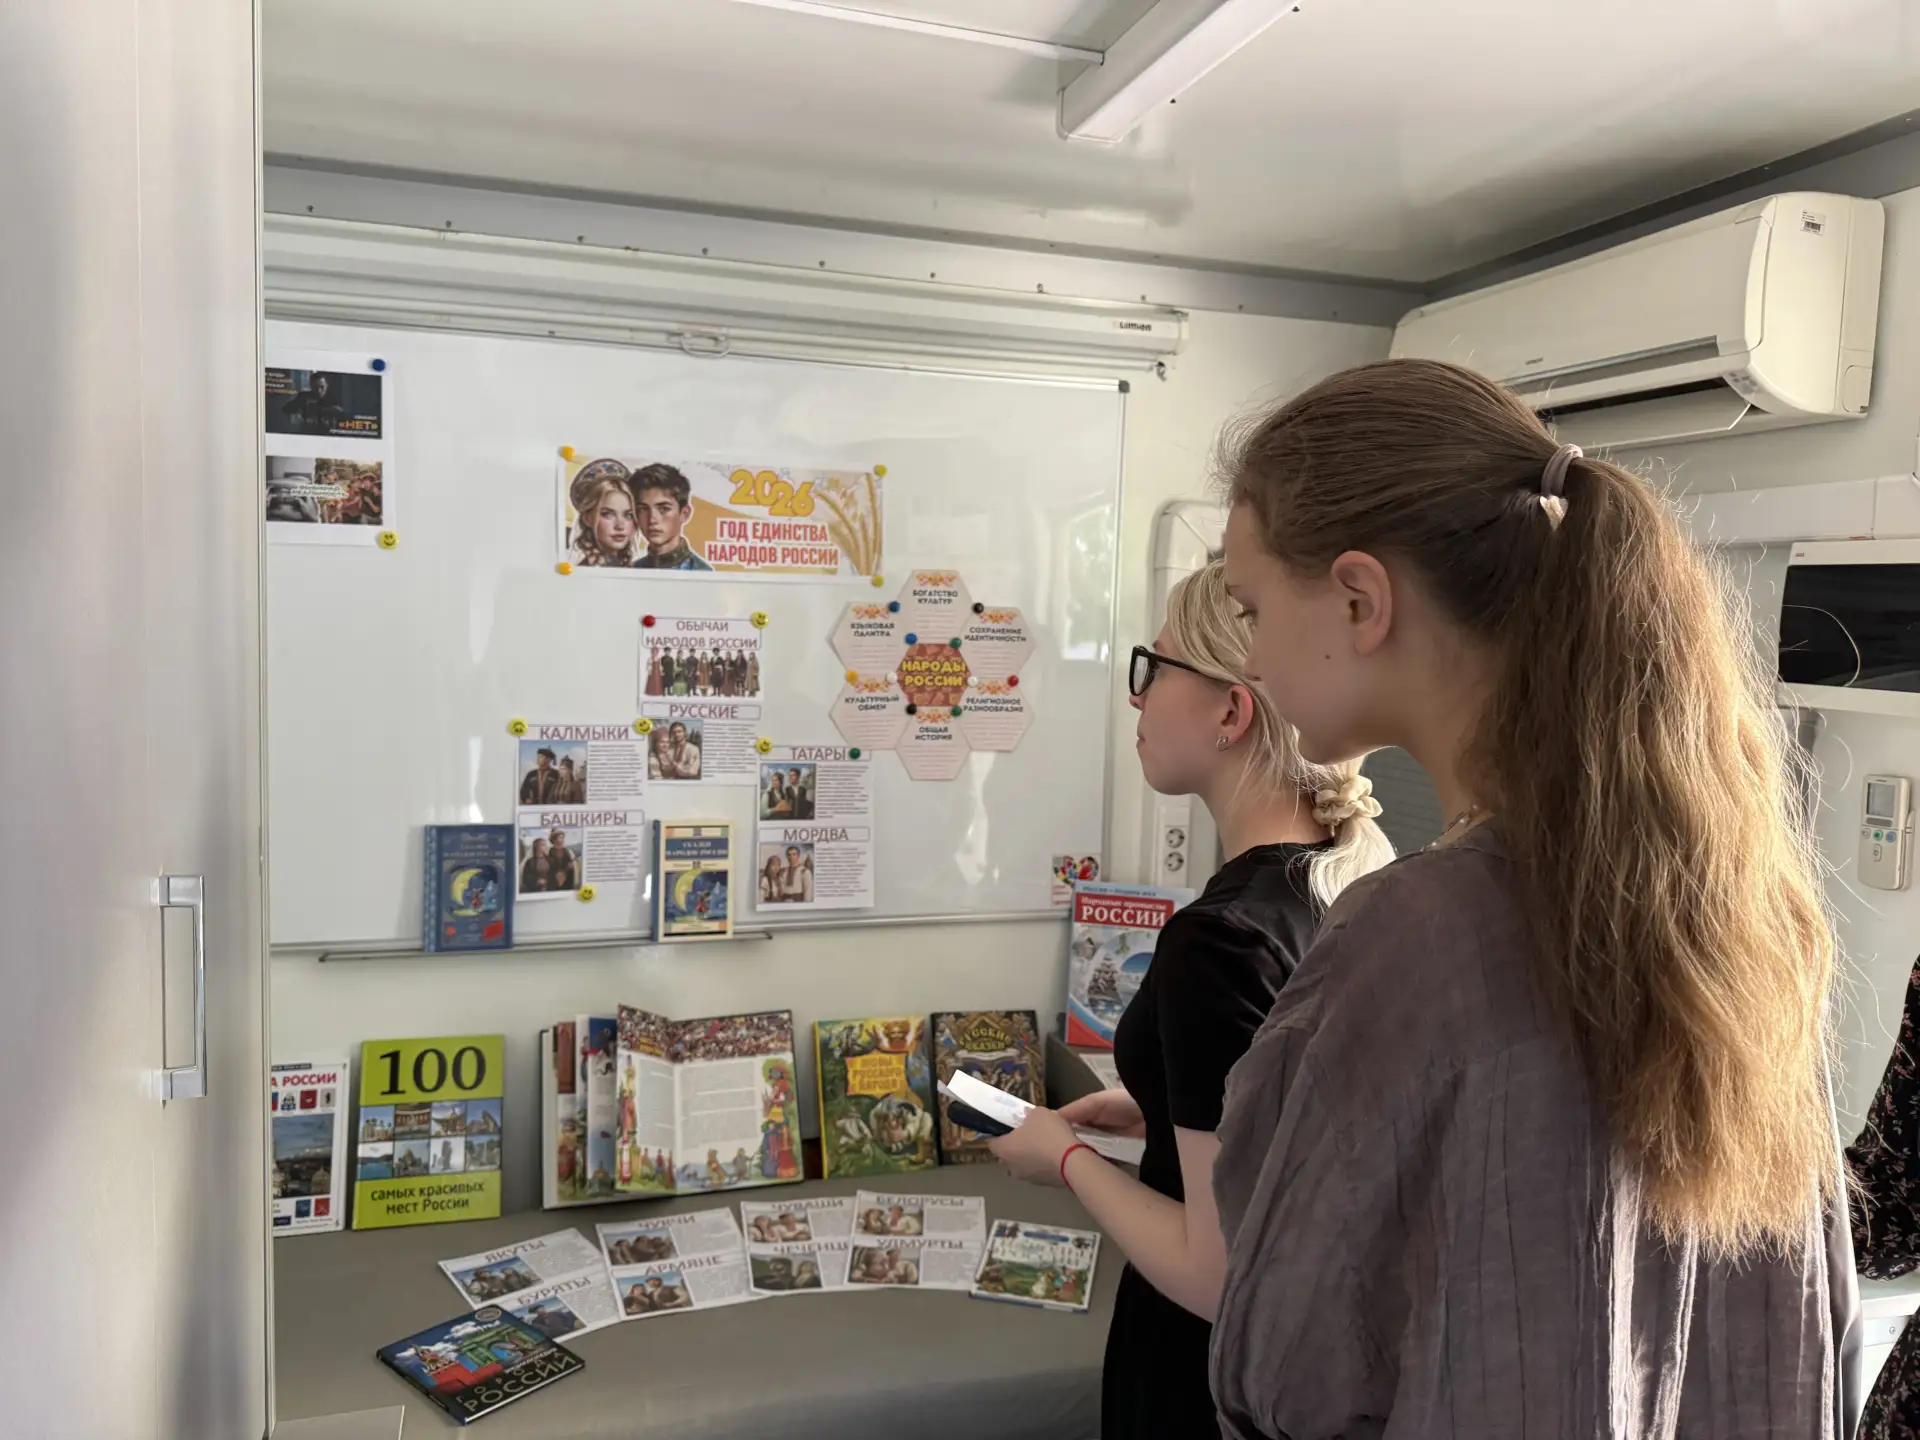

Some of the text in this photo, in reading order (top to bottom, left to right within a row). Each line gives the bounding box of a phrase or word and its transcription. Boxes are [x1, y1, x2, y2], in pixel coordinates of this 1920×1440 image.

[729, 469, 815, 517] 2026
[718, 520, 828, 543] ГОД ЕДИНСТВА
[707, 544, 838, 566] НАРОДОВ РОССИИ
[912, 589, 958, 597] БОГАТСТВО
[645, 636, 758, 648] НАРОДОВ РОССИИ
[902, 660, 966, 673] НАРОДЫ
[904, 675, 963, 687] РОССИИ
[844, 694, 900, 703] КУЛЬТУРНЫЙ
[965, 697, 1021, 705] РЕЛИГИОЗНОЕ
[669, 703, 739, 719] РУССКИЕ
[539, 726, 630, 741] КАЛМЫКИ
[790, 747, 846, 761] ТАТАРЫ
[540, 811, 628, 827] БАШКИРЫ
[783, 828, 849, 844] МОРДВА
[1081, 905, 1166, 927] РОССИИ
[379, 1046, 486, 1096] 100
[282, 1072, 337, 1087] РОССИИ
[371, 1182, 485, 1202] самых красивых
[386, 1198, 470, 1216] мест России
[875, 1195, 965, 1207] БЕЛОРУСЫ
[484, 1239, 547, 1263] ЯКУТЫ
[877, 1239, 963, 1250] УДМУРТЫ
[517, 1276, 592, 1306] БУРЯТЫ
[464, 1355, 577, 1413] РОССИИ
